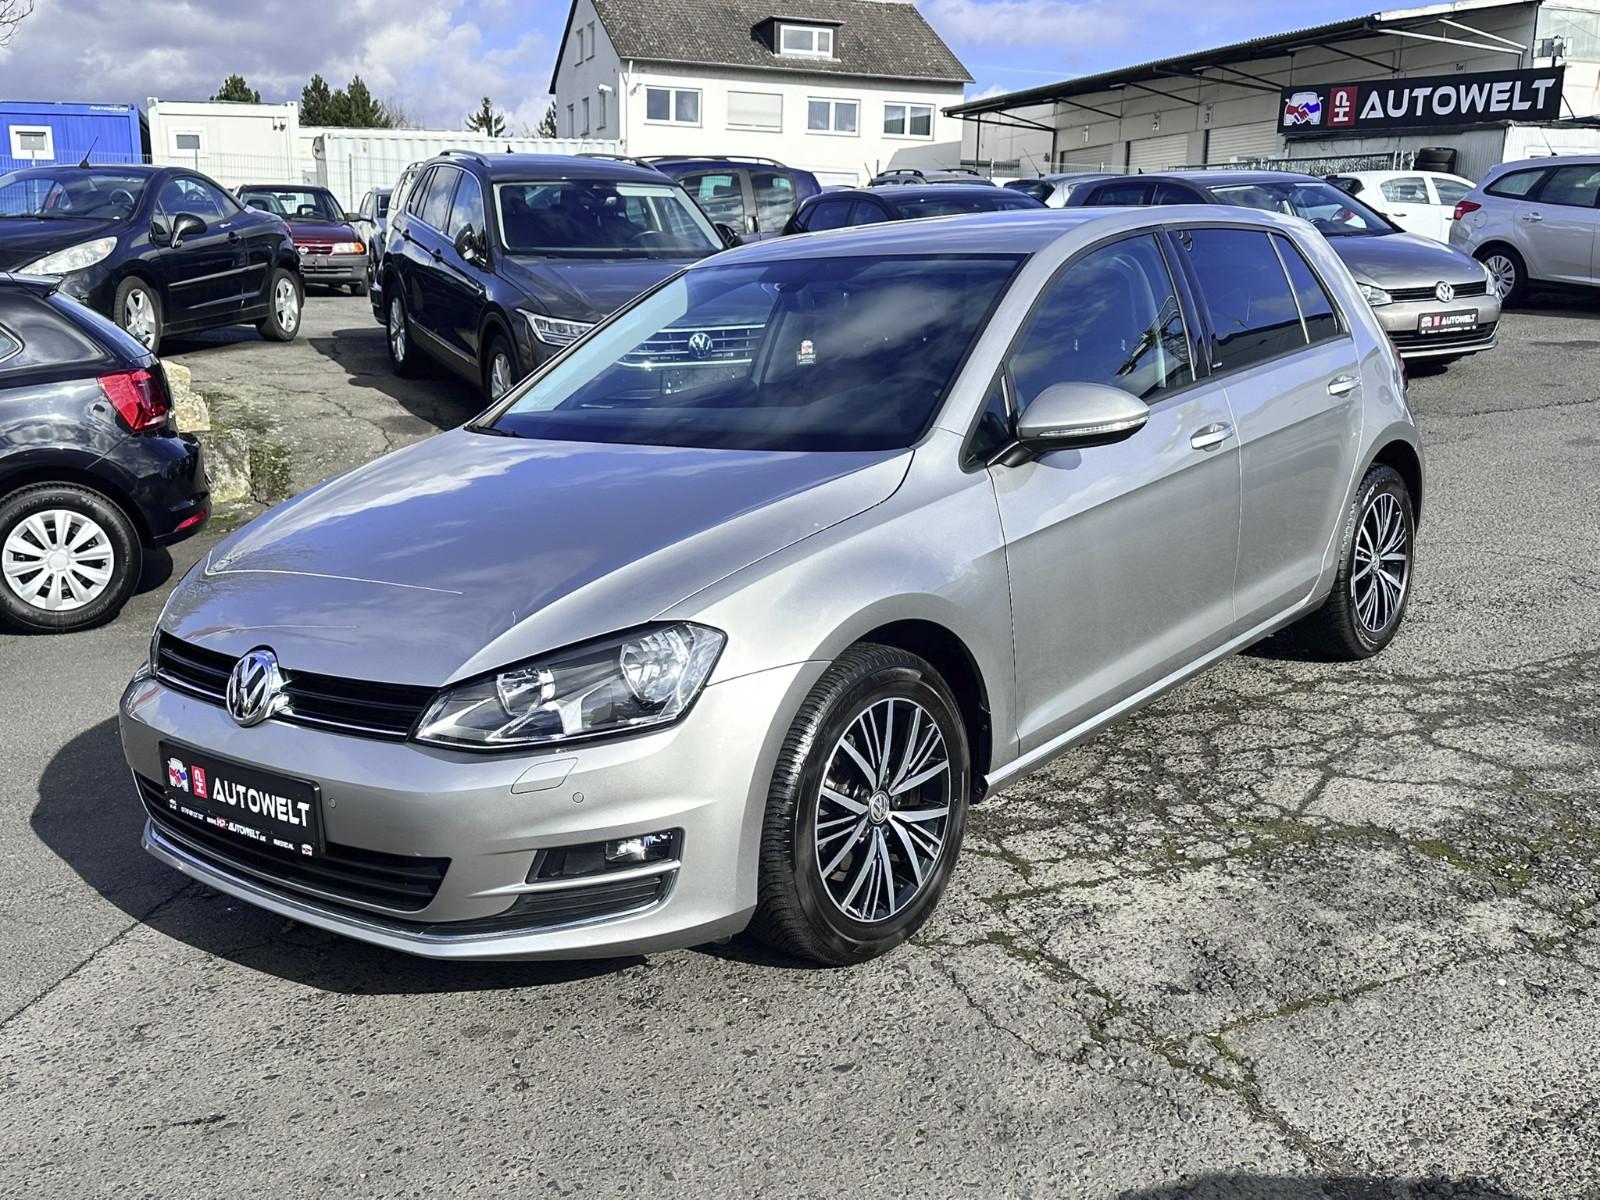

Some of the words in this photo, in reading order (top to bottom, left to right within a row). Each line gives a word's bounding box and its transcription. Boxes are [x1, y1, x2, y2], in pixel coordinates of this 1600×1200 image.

[1359, 79, 1555, 119] AUTOWELT
[1441, 314, 1476, 325] AUTOWELT
[212, 777, 310, 827] AUTOWELT
